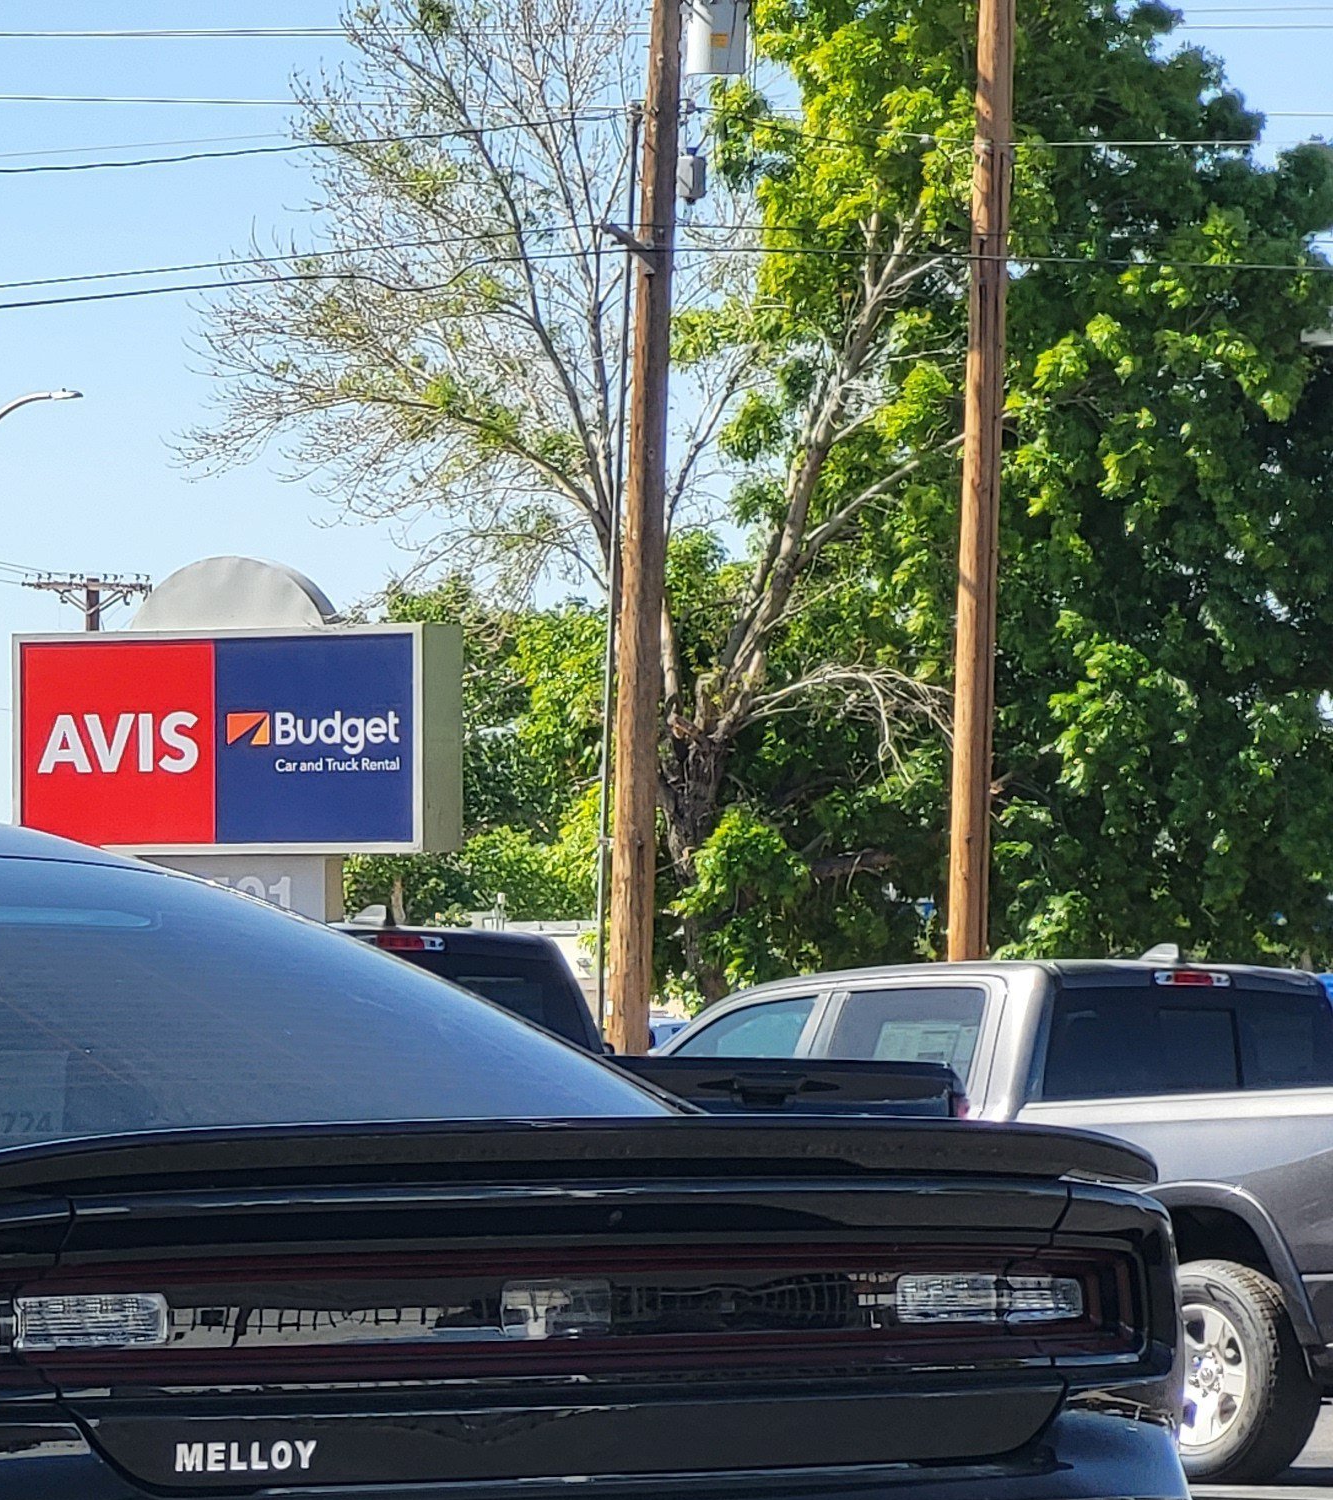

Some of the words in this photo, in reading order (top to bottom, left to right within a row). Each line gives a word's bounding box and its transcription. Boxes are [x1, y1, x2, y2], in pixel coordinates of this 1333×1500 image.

[37, 711, 199, 774] AVIS
[274, 710, 401, 755] Budget
[275, 758, 298, 772] Car
[299, 757, 323, 772] and
[325, 757, 359, 772] Truck
[361, 756, 401, 771] Rental
[174, 1440, 318, 1472] MELLOY
